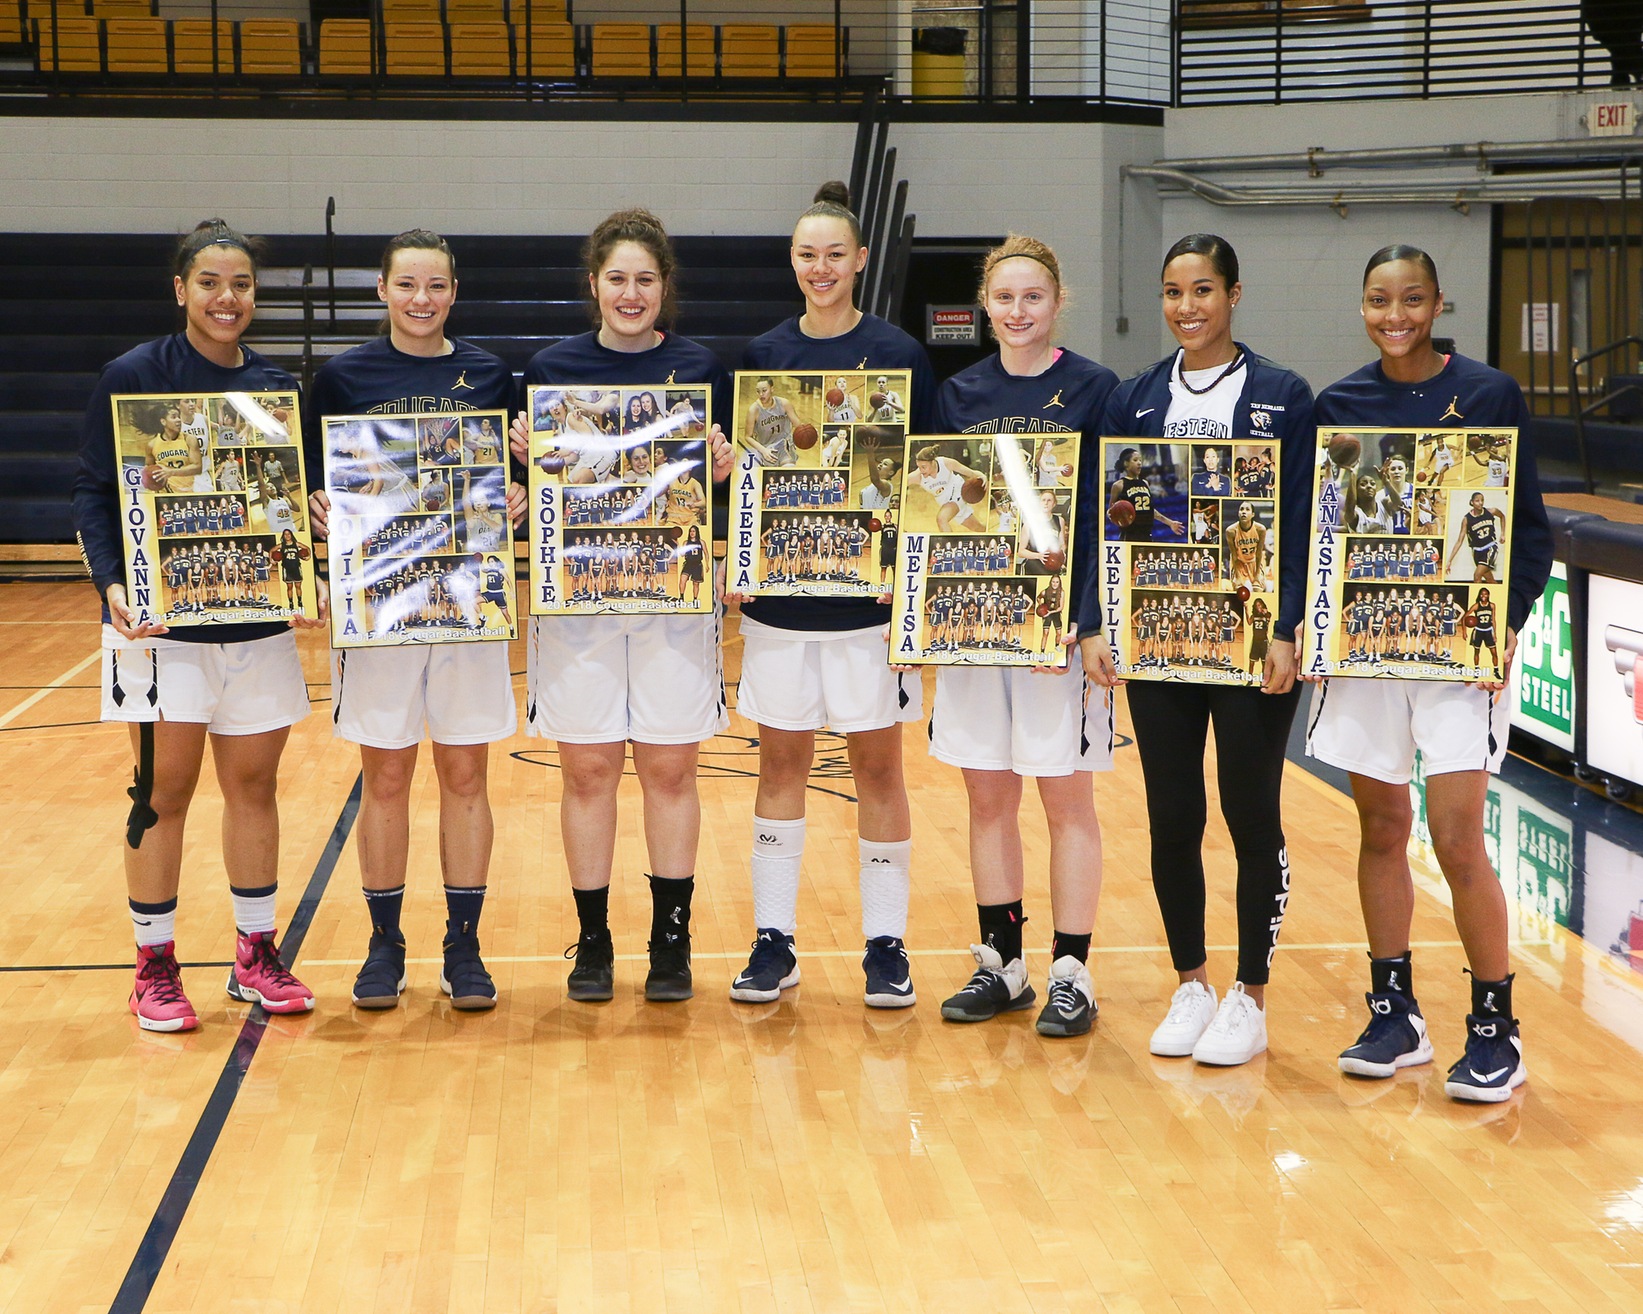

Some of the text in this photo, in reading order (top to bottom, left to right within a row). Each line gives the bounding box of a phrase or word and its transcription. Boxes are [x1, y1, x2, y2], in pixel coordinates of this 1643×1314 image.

[1598, 105, 1628, 127] EXIT
[366, 396, 480, 414] OUGAR
[840, 411, 849, 421] 11
[962, 417, 1074, 433] OUGAR
[157, 449, 189, 461] COUGARS
[483, 447, 492, 456] 21
[1126, 486, 1150, 497] COUGAR
[1134, 496, 1151, 511] 22
[276, 508, 290, 519] 42
[736, 453, 756, 587] JALEESA
[1476, 527, 1490, 539] 33
[124, 468, 154, 627] GIOVANNA
[539, 487, 556, 603] SOPHIE
[1310, 483, 1338, 674] ANASTACIA
[741, 581, 893, 594] 2017-18 Cougar Basketball
[900, 535, 925, 653] MELISA
[546, 599, 701, 612] 2017-18 Cougar Basketball
[1105, 546, 1121, 666] KELLIE
[148, 607, 305, 624] 2017-18 Cougar Basketball
[1479, 615, 1490, 624] 33
[1254, 621, 1263, 630] 22
[348, 626, 506, 643] 2017-18 Cougar Basketball
[1523, 590, 1571, 681] B&C
[903, 650, 1055, 663] 2017-18 Cougar Basketball
[1115, 664, 1263, 682] 2017-18 Cougar Basketbal
[1318, 659, 1490, 677] 2017-18 Cougar Basketball
[1521, 672, 1570, 721] STEEL
[1266, 846, 1290, 969] adidas
